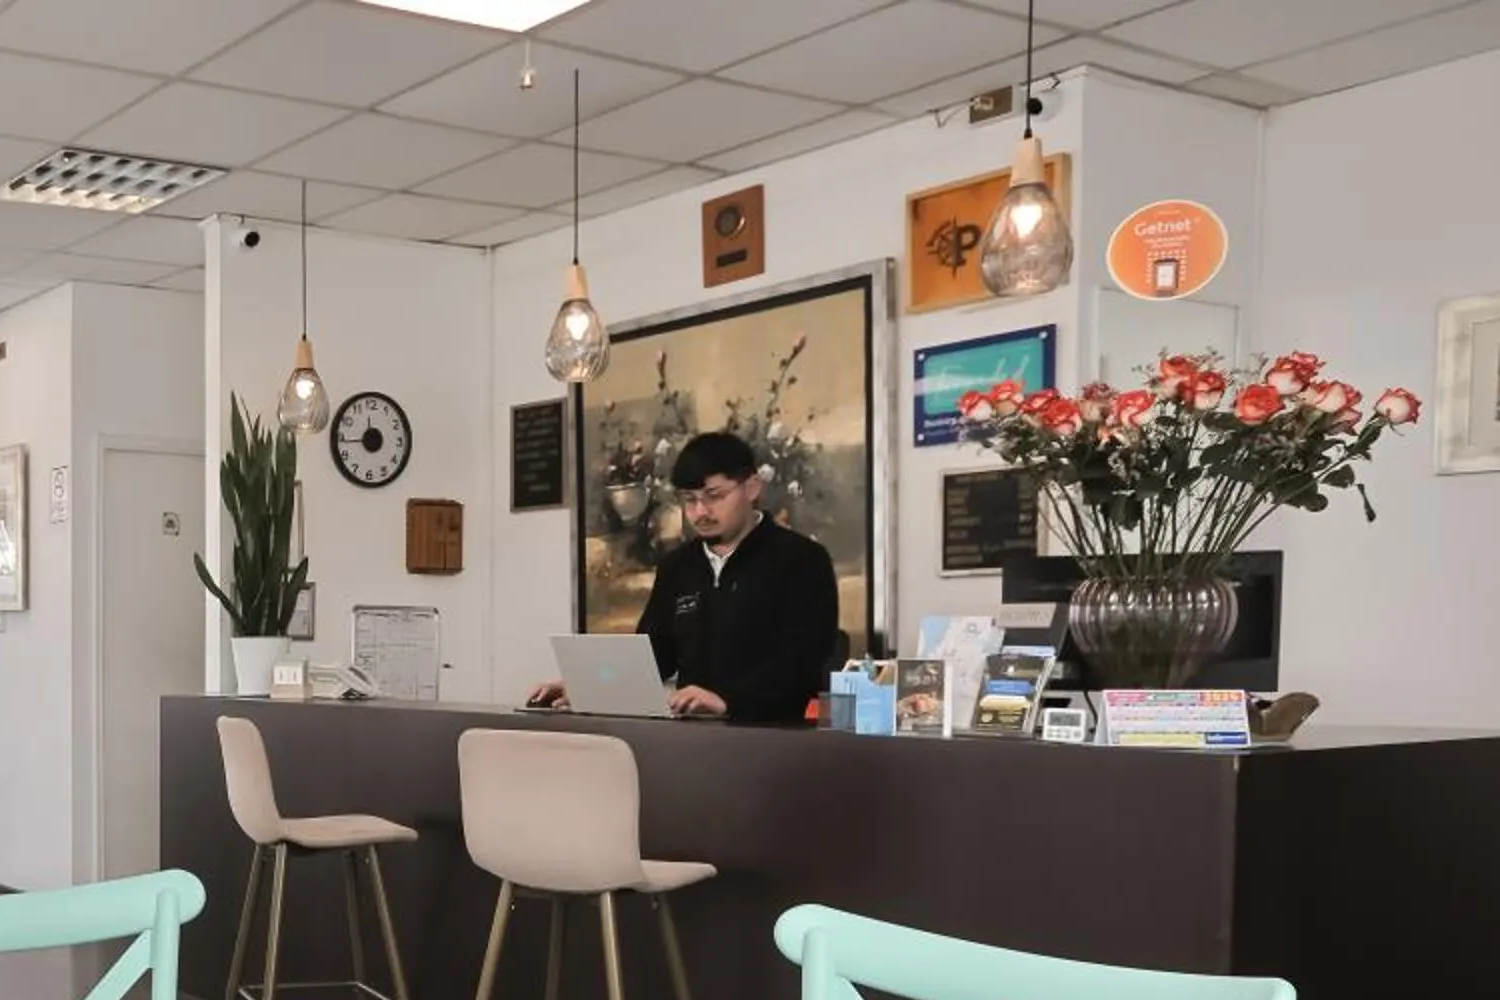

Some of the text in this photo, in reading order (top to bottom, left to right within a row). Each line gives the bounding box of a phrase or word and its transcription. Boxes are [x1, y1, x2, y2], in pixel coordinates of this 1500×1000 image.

[1133, 217, 1191, 237] Getnet
[365, 399, 379, 411] 12
[392, 419, 399, 430] 2
[395, 437, 403, 448] 3
[351, 463, 359, 473] 7
[365, 469, 373, 480] 6
